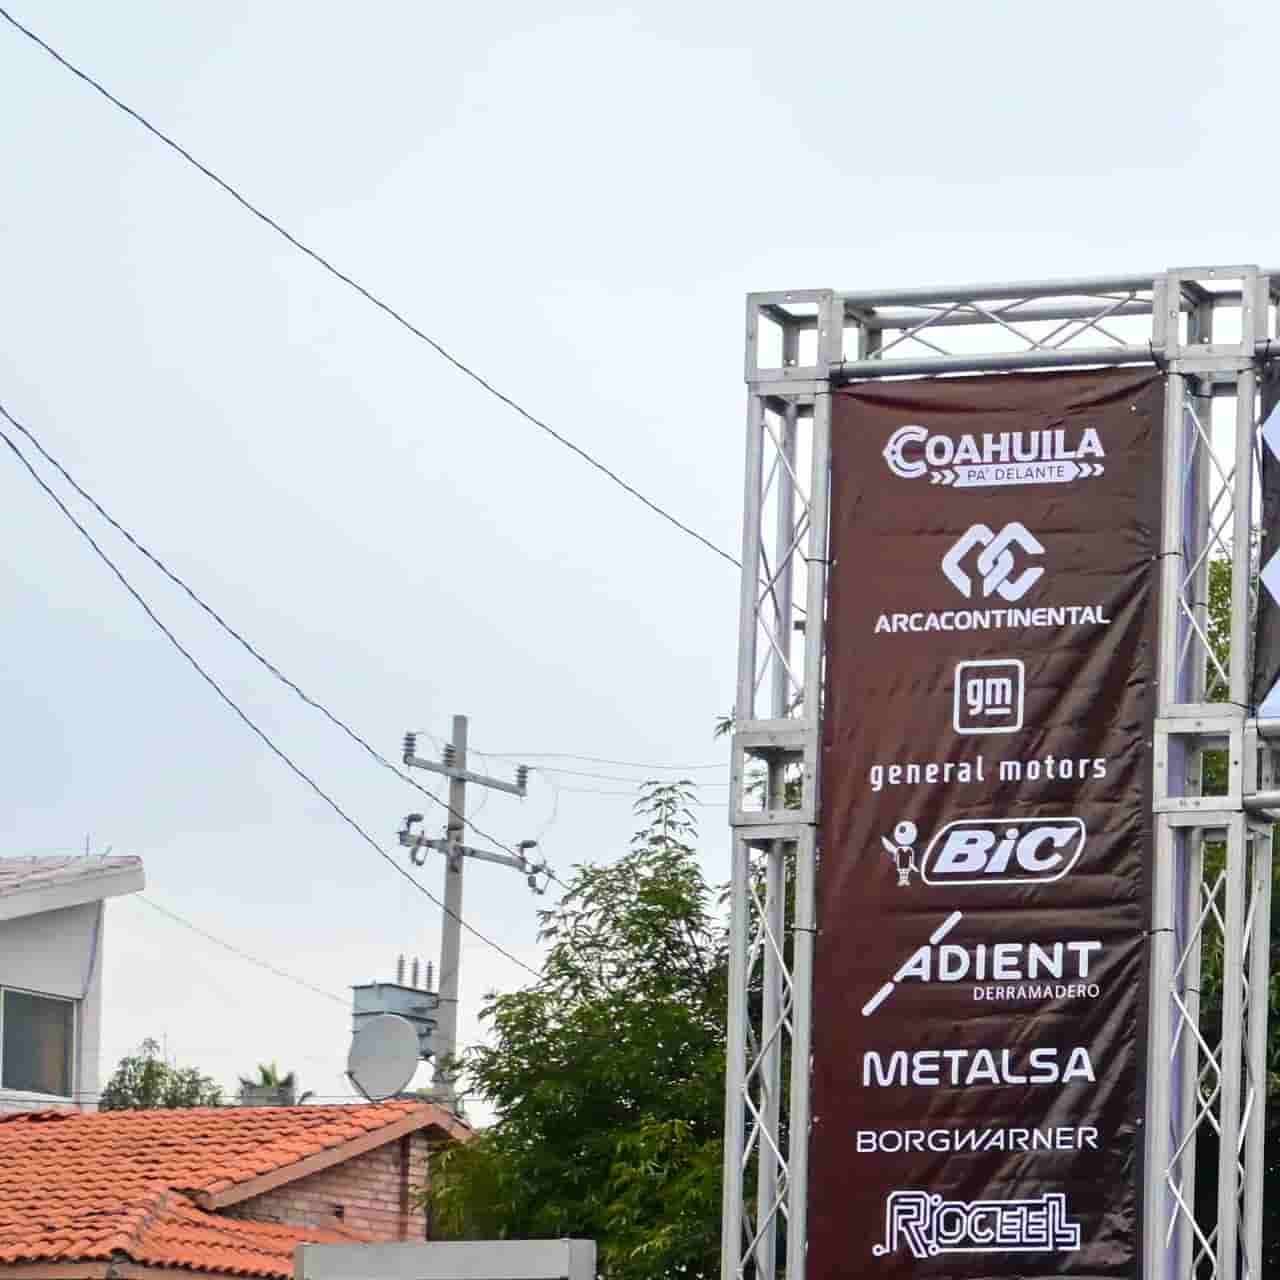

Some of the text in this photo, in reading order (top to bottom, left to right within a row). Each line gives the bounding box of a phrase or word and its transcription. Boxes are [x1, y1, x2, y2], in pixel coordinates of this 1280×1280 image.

[883, 425, 1105, 478] COAHUILA
[995, 466, 1065, 481] DELANTE
[874, 606, 1111, 633] ARCACONTINENTAL
[967, 677, 1012, 716] gm
[870, 754, 1107, 791] general motors
[893, 941, 1101, 983] ADIENT
[973, 983, 1100, 1001] DERRAMADERO
[863, 1047, 1097, 1087] METALSA
[856, 1127, 1099, 1152] BORGWARNER
